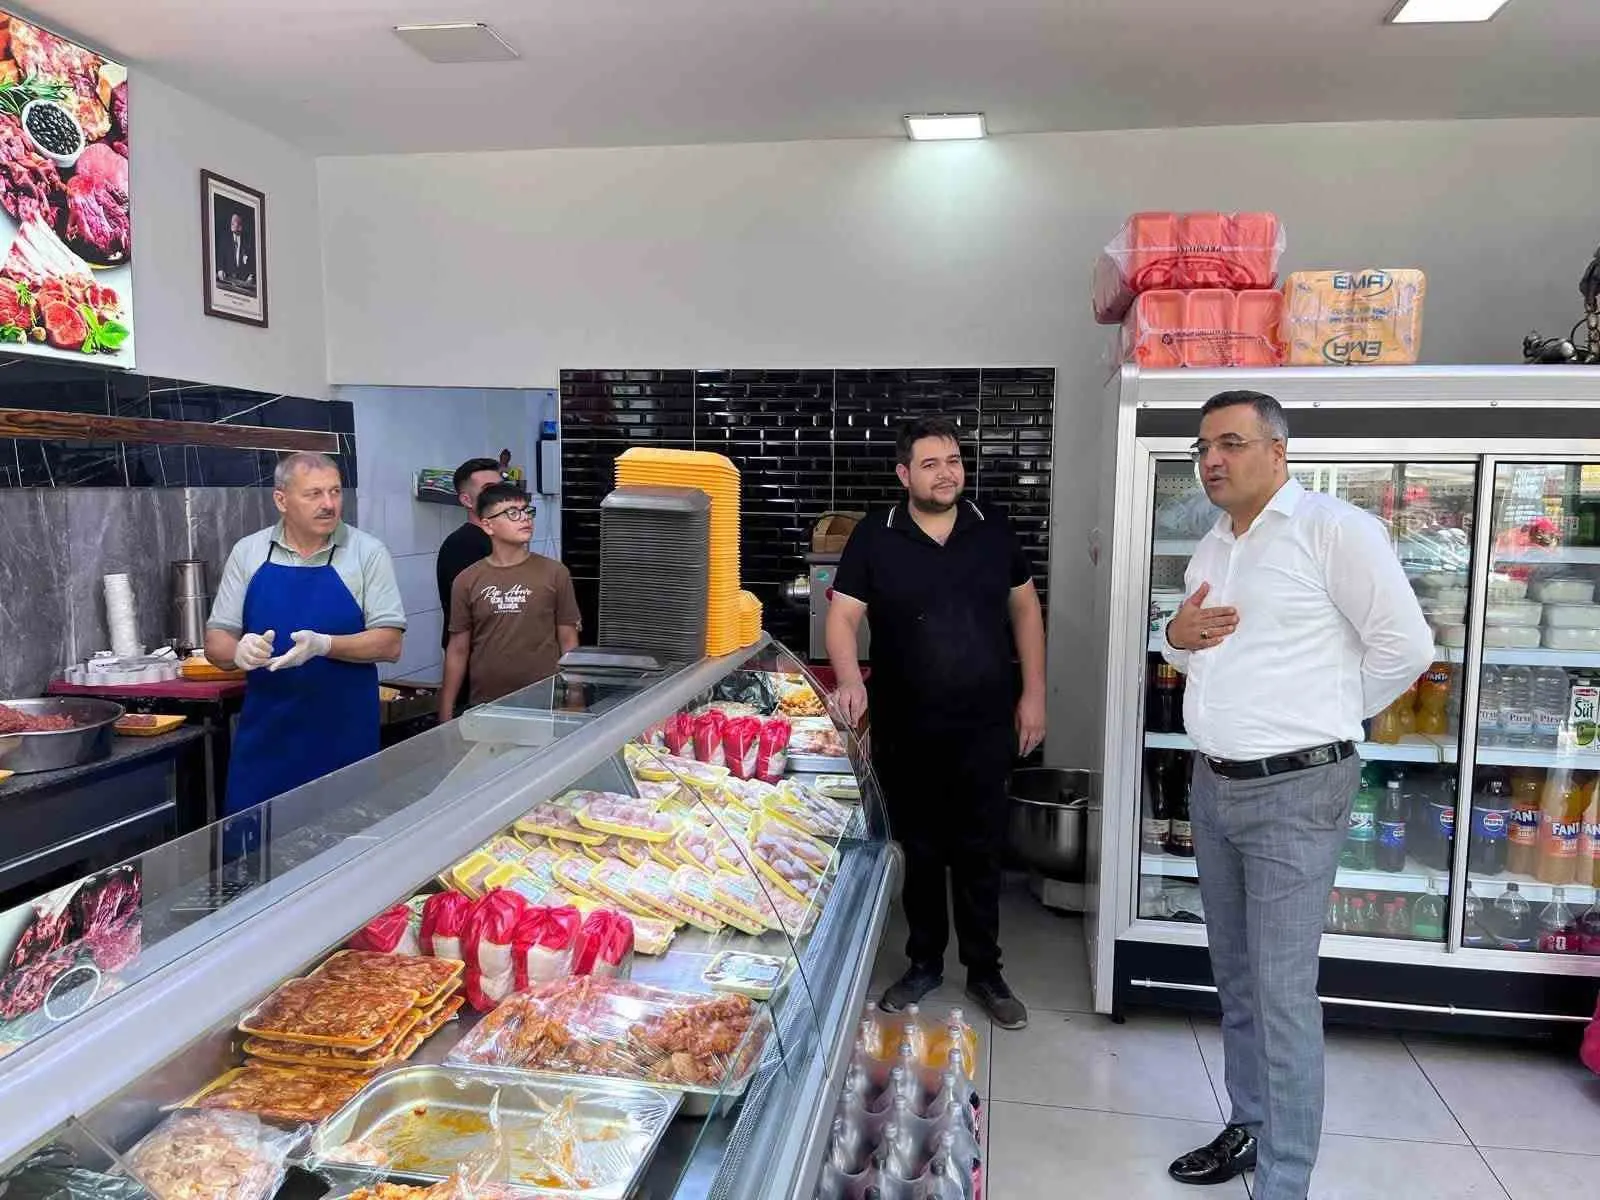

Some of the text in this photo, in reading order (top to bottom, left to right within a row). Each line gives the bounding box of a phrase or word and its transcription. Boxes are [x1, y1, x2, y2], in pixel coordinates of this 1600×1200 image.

[1333, 274, 1385, 290] EMA
[1333, 340, 1383, 357] EMA
[1574, 701, 1594, 719] Süt
[1510, 810, 1537, 822] FANT
[1552, 822, 1579, 836] FANT
